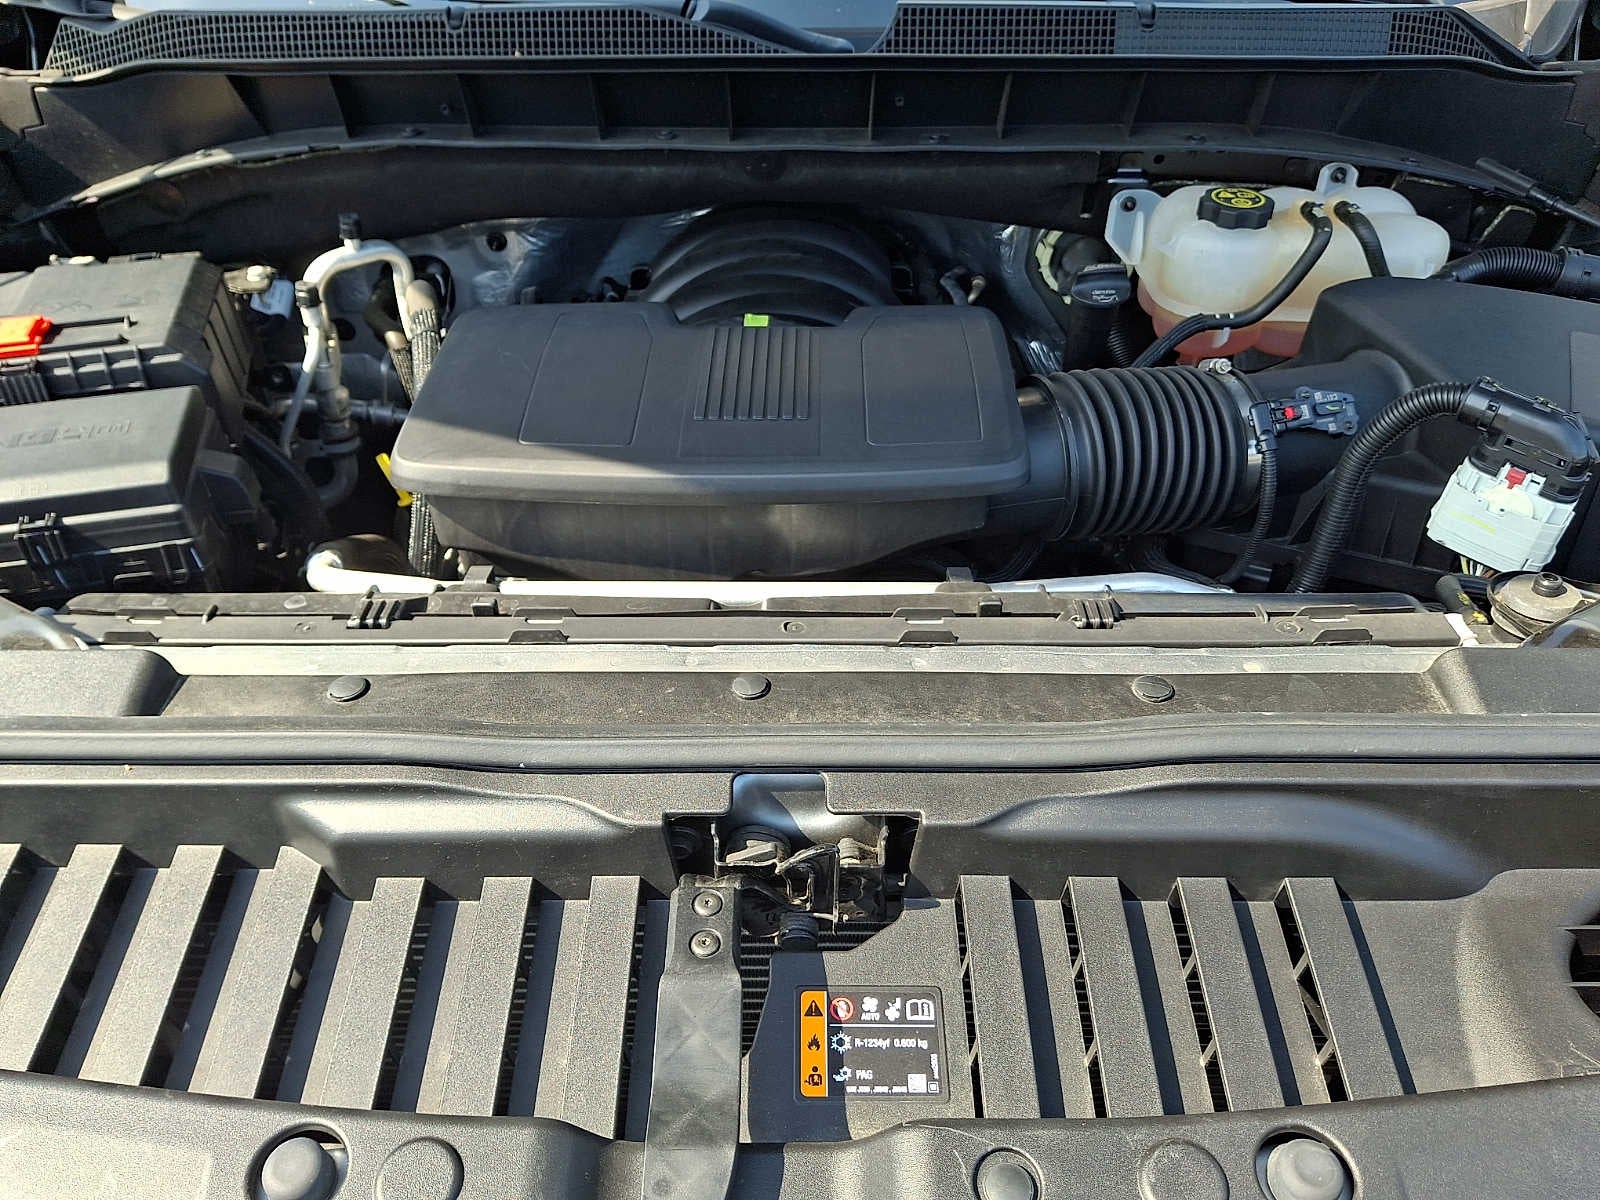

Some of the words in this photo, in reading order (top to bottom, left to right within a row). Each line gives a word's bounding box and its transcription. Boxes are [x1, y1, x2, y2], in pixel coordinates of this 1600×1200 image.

[861, 1013, 879, 1021] AUTO
[855, 1038, 890, 1050] R-1234yf
[918, 1038, 928, 1050] kg
[856, 1070, 873, 1080] PAG
